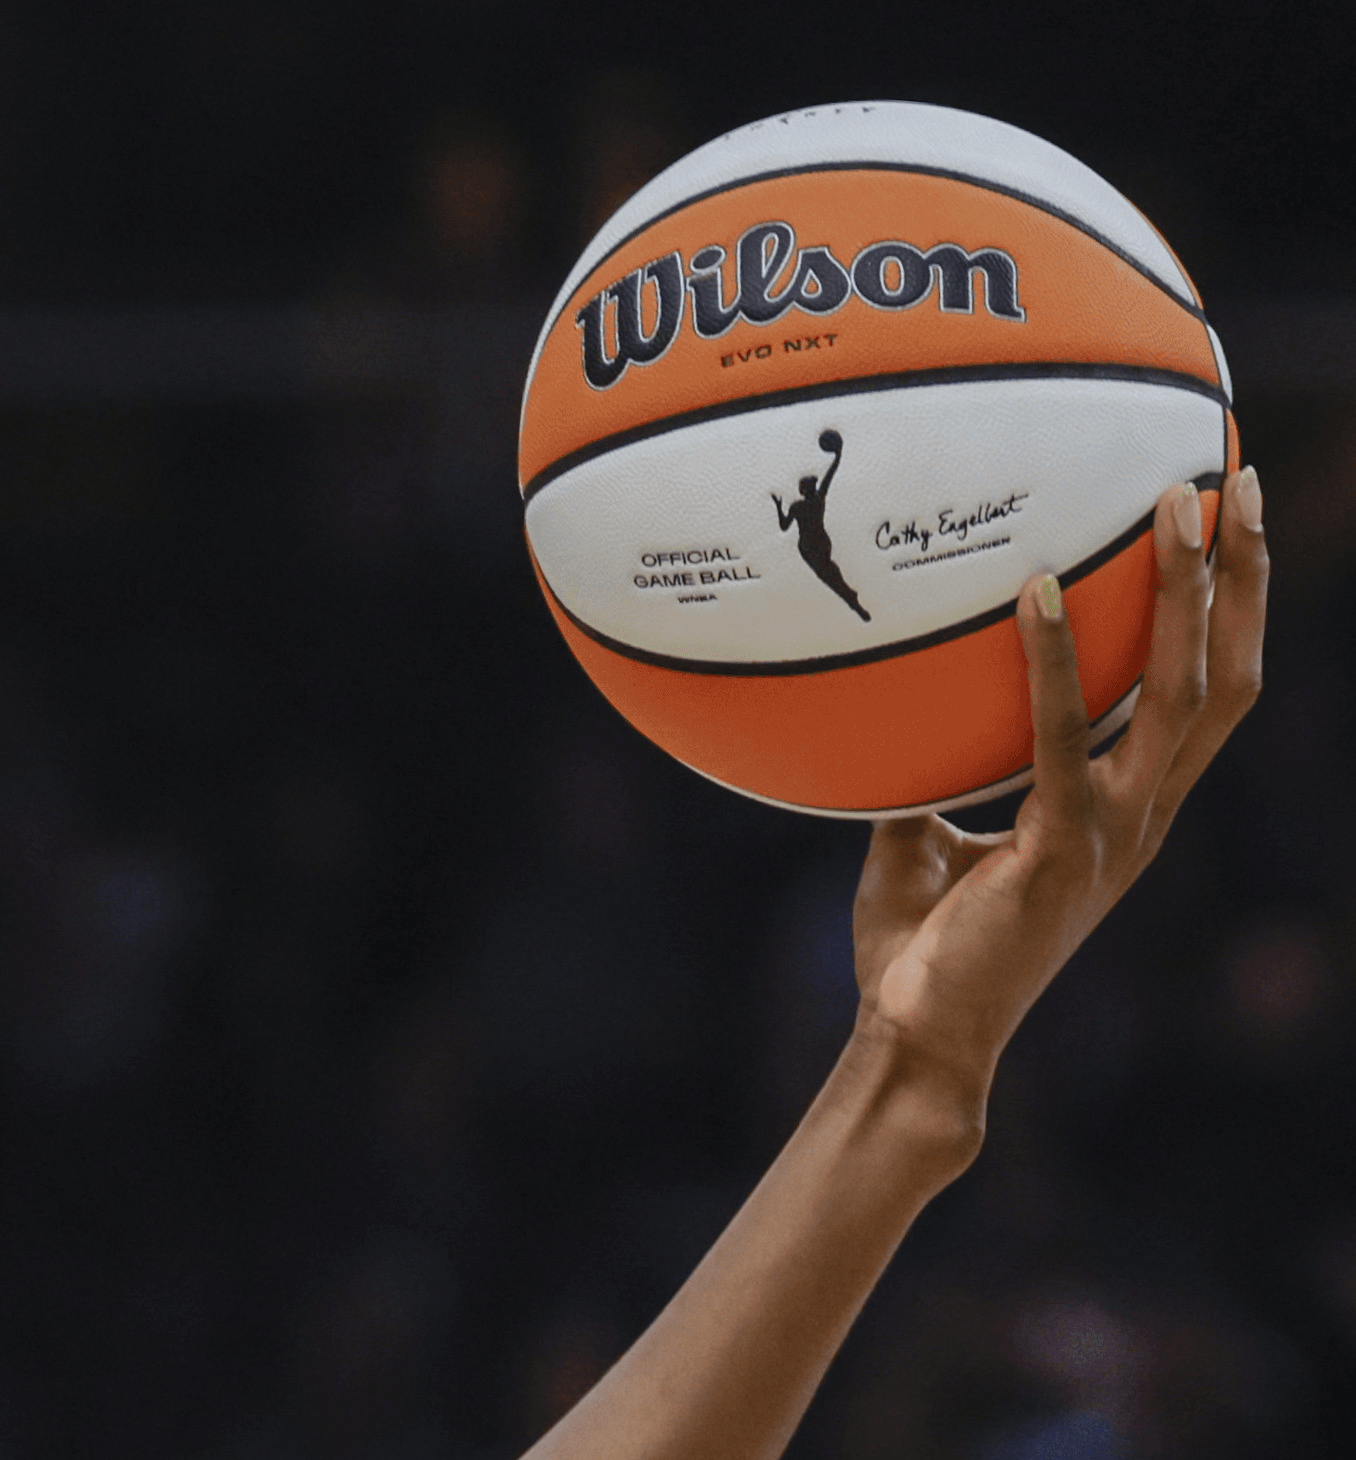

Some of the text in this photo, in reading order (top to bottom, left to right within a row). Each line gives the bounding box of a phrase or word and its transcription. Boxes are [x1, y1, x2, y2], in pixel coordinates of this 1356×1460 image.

[576, 221, 1027, 390] Wilson
[720, 333, 838, 368] EVO NXT
[875, 519, 934, 552] Cathy
[641, 547, 741, 567] OFFICIAL
[892, 536, 1011, 571] COMMISSIONER
[633, 566, 761, 589] GAME BALL
[677, 593, 718, 604] WNBA
